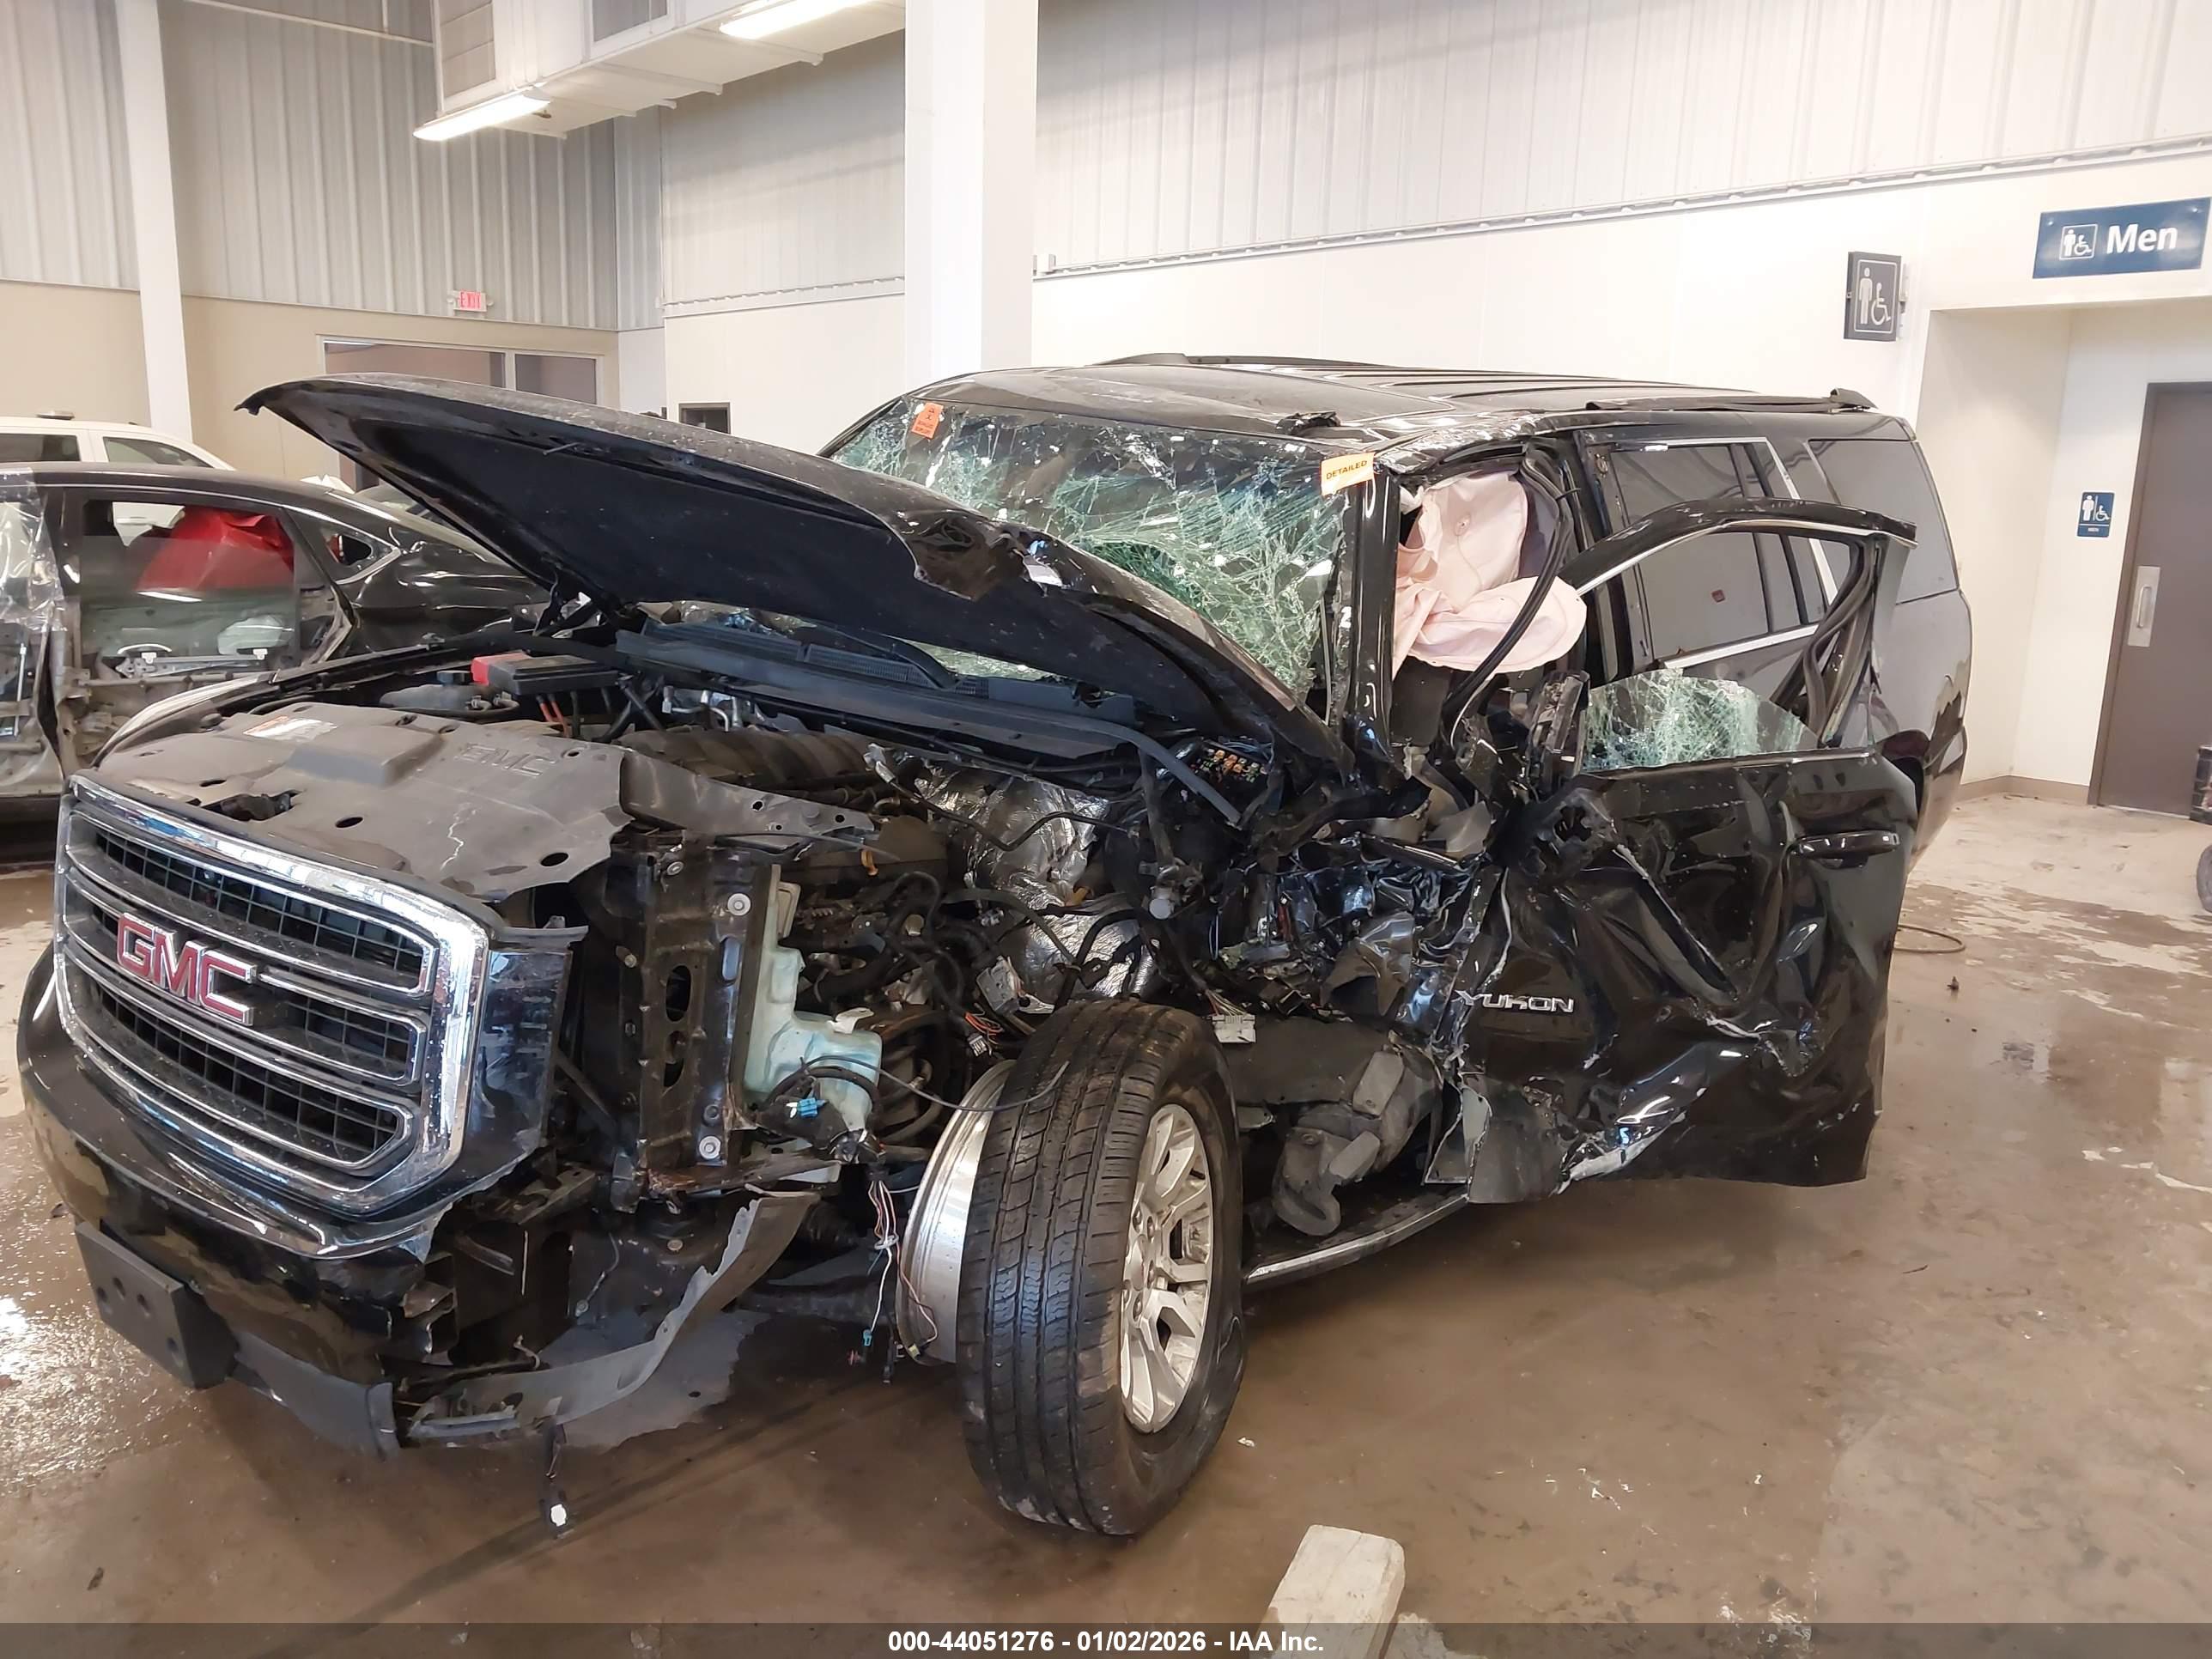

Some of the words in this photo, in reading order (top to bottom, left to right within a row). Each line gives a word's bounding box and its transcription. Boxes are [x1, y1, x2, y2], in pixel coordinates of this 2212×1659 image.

[2106, 223, 2178, 254] Men
[1326, 460, 1367, 479] DETAILED
[117, 913, 257, 1026] GMC
[1451, 990, 1574, 1013] YUKON
